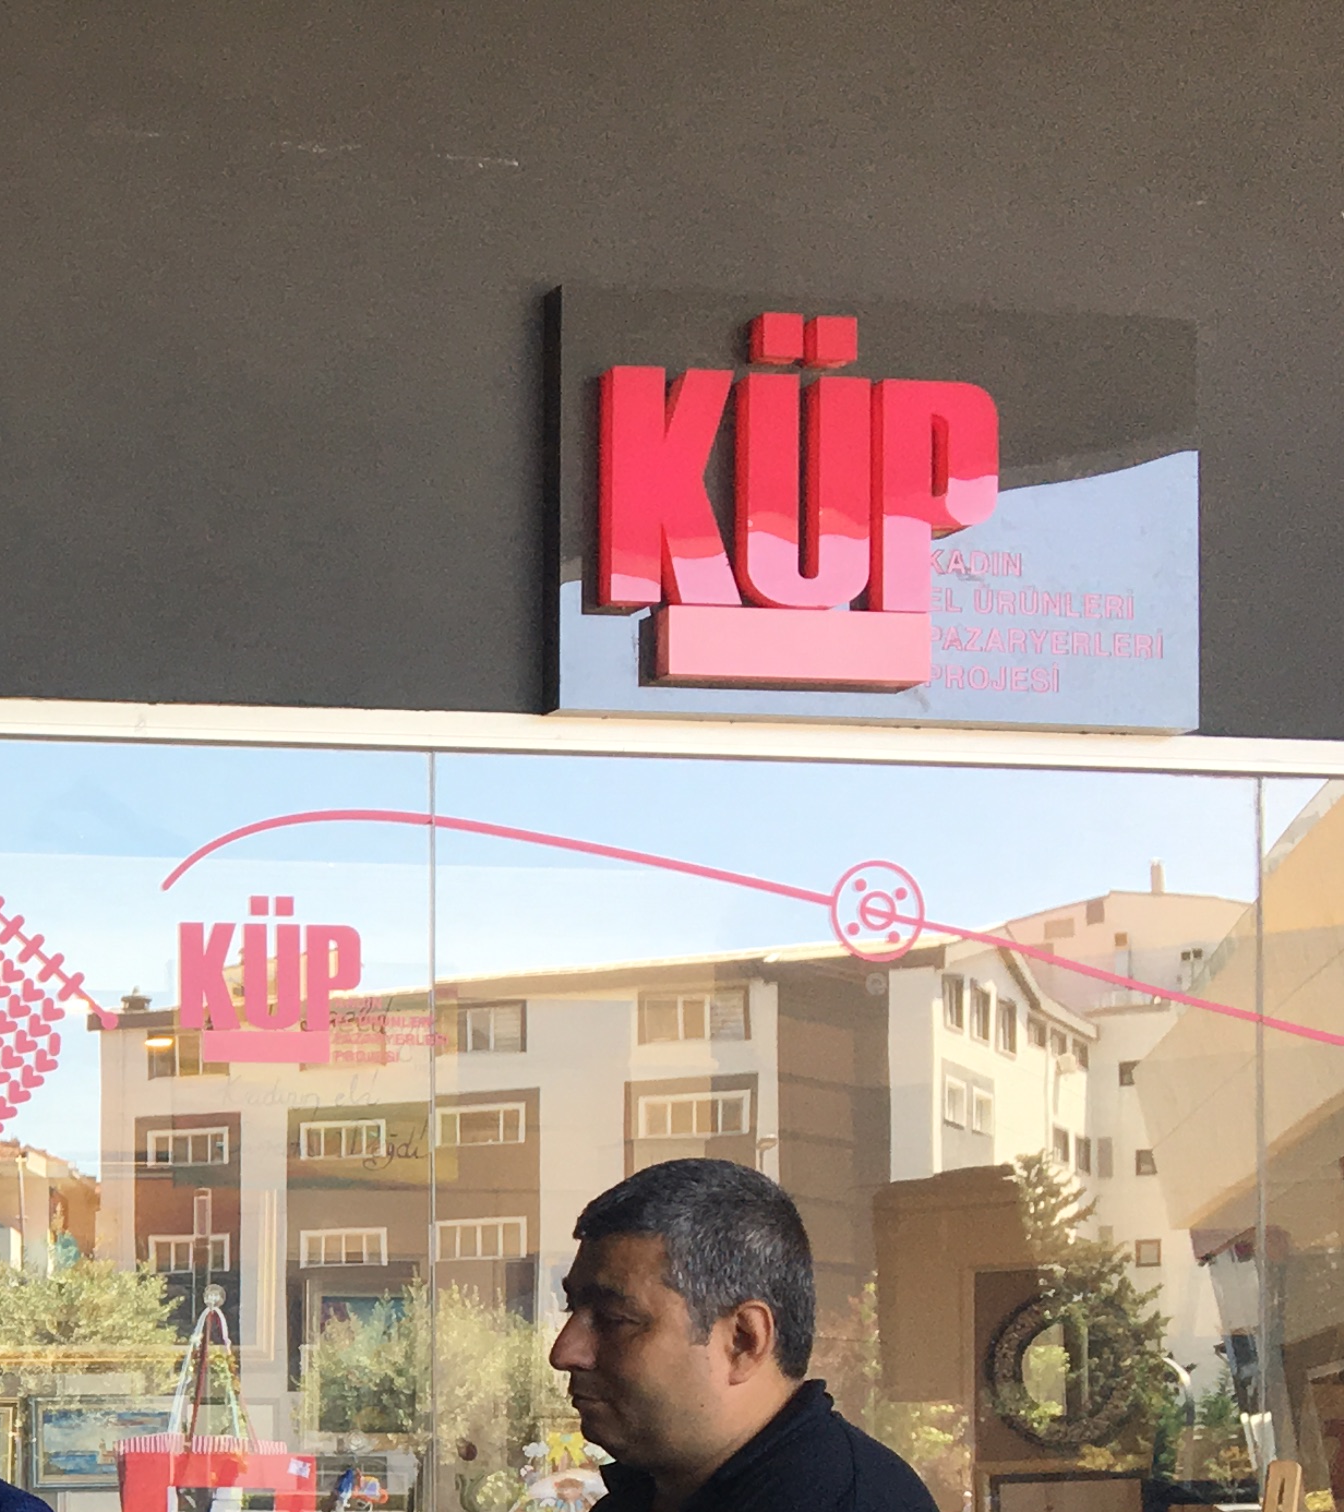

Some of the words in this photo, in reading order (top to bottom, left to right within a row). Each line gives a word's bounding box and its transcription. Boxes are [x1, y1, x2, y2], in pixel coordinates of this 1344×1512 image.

[600, 313, 998, 612] KÜP
[930, 549, 1022, 577] KADIN
[930, 587, 962, 614] EL
[973, 584, 1135, 621] ÜRÜNLERİ
[930, 625, 1164, 660] PAZARYERLERİ
[926, 662, 1060, 693] PROJESİ
[178, 896, 362, 1031] KÜP
